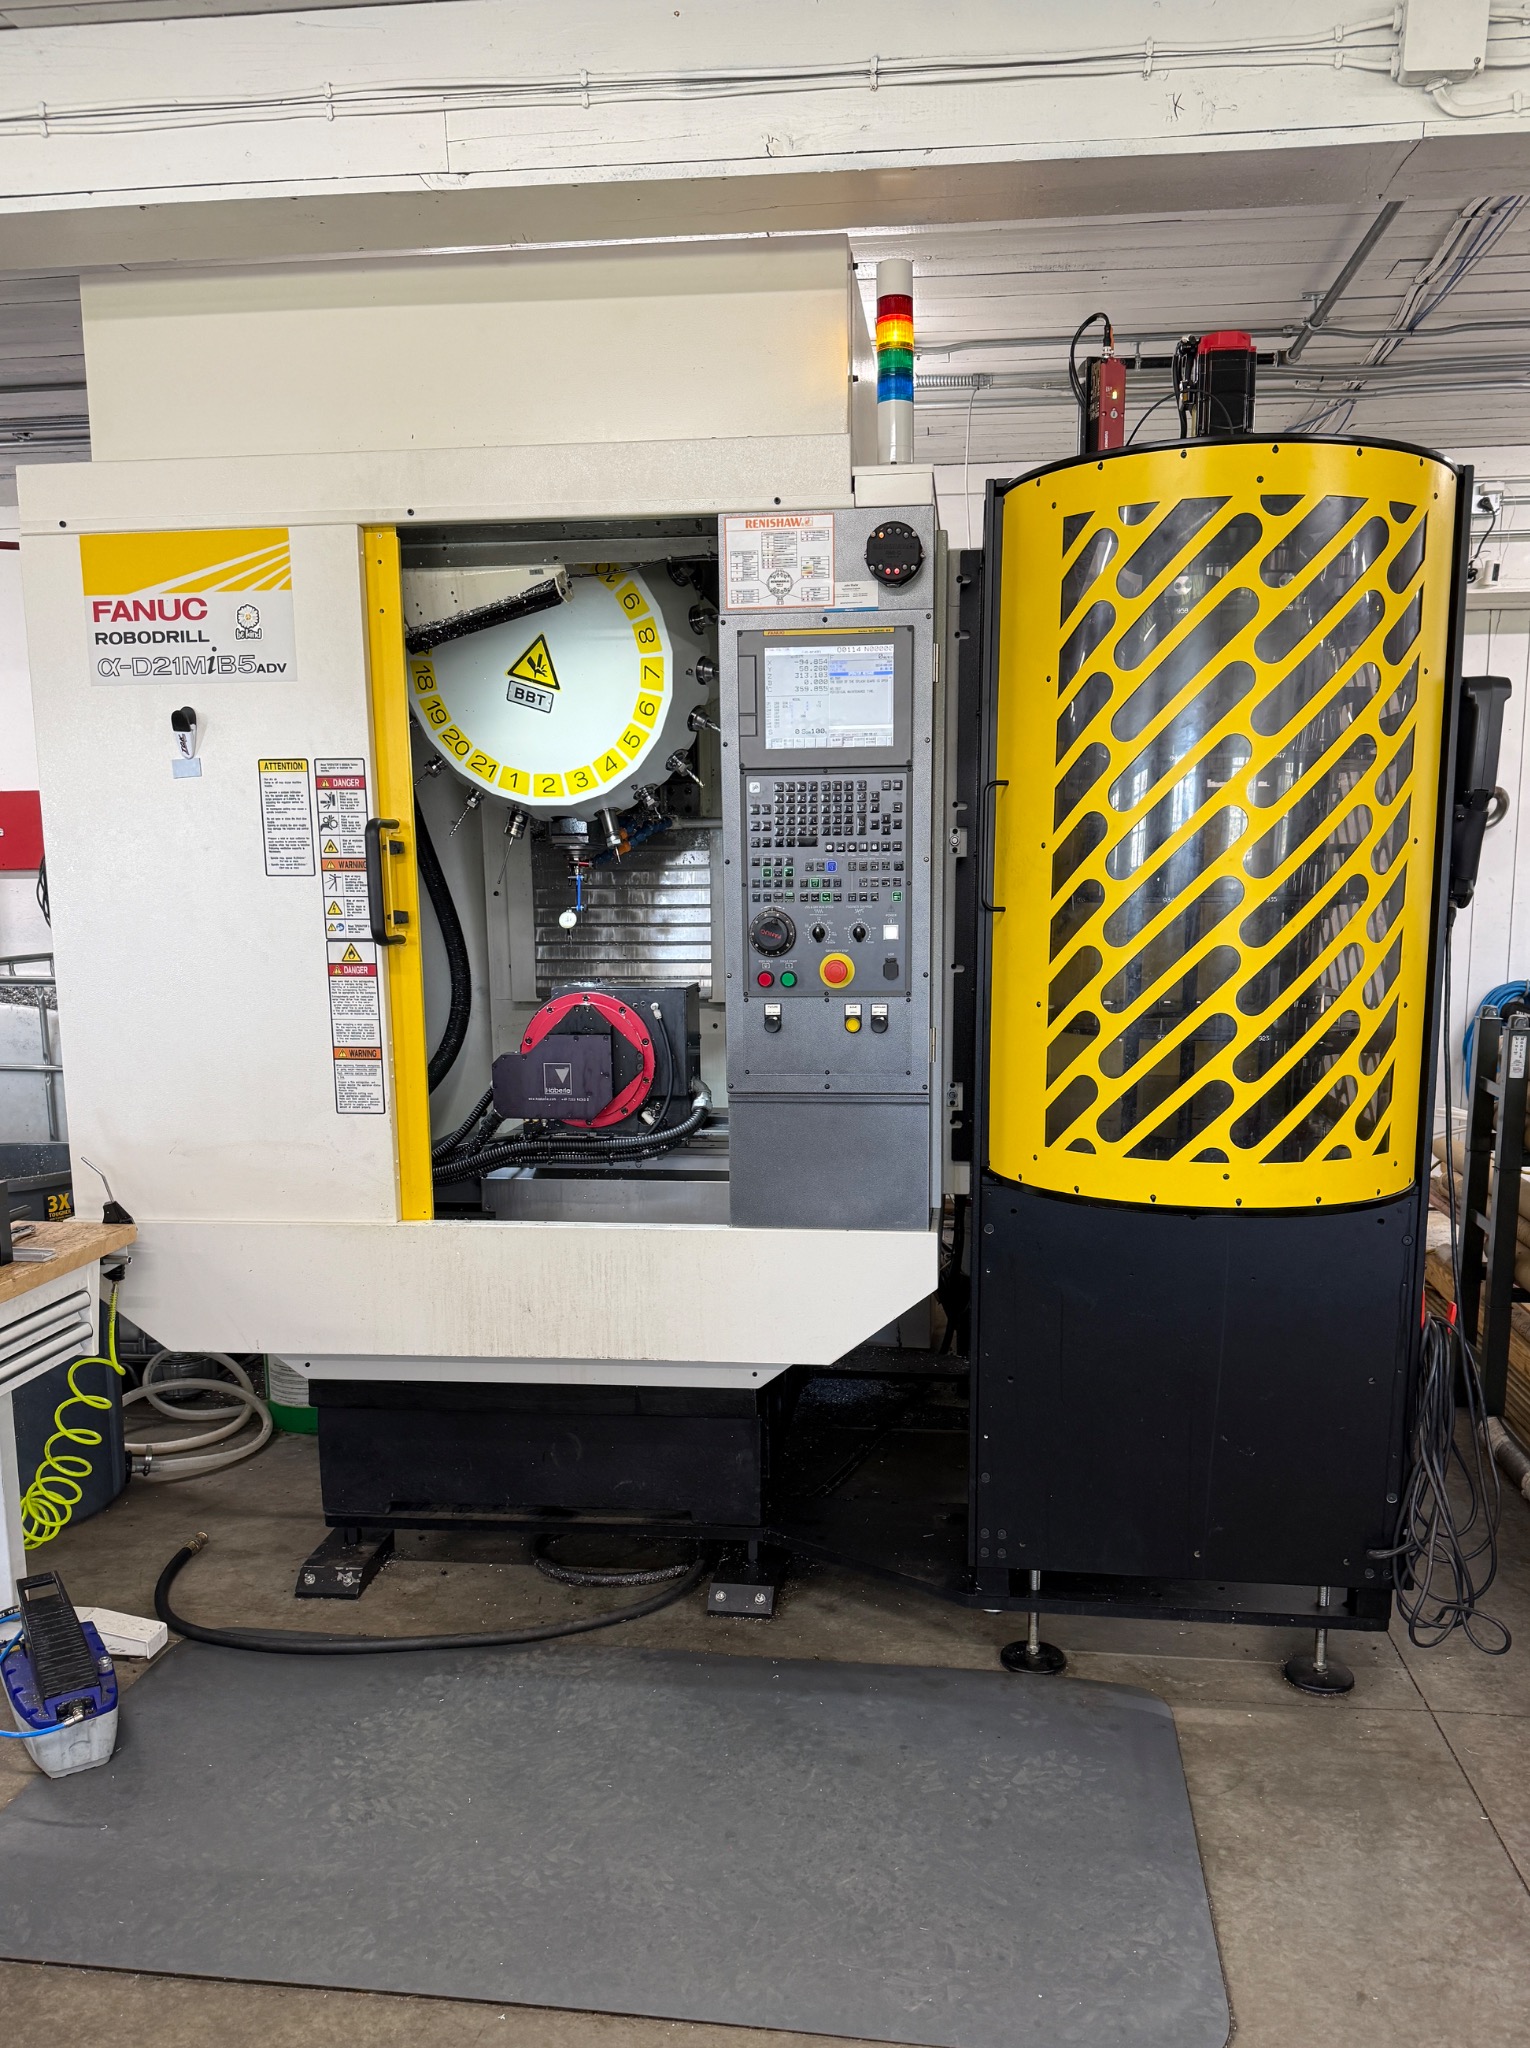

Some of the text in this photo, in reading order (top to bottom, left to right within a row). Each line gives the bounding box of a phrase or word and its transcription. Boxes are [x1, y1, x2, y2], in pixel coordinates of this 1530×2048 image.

[745, 518, 803, 528] RENISHAW
[624, 593, 640, 610] 9
[92, 598, 208, 622] FANUC
[94, 630, 210, 645] ROBODRILL
[638, 627, 655, 643] 8
[415, 664, 434, 690] 18
[644, 665, 660, 680] 7
[514, 687, 546, 706] BBT
[426, 700, 447, 725] 19
[638, 700, 655, 716] 6
[442, 728, 470, 756] 20
[622, 731, 640, 748] 5
[264, 762, 303, 770] ATTENTION
[470, 755, 498, 778] 21
[605, 756, 618, 772] 4
[332, 778, 360, 787] DANGER
[510, 773, 518, 788] 1
[542, 777, 556, 793] 2
[574, 772, 589, 788] 3
[344, 966, 368, 974] DANGER
[349, 1050, 376, 1058] WARNING
[48, 1192, 70, 1212] 3X
